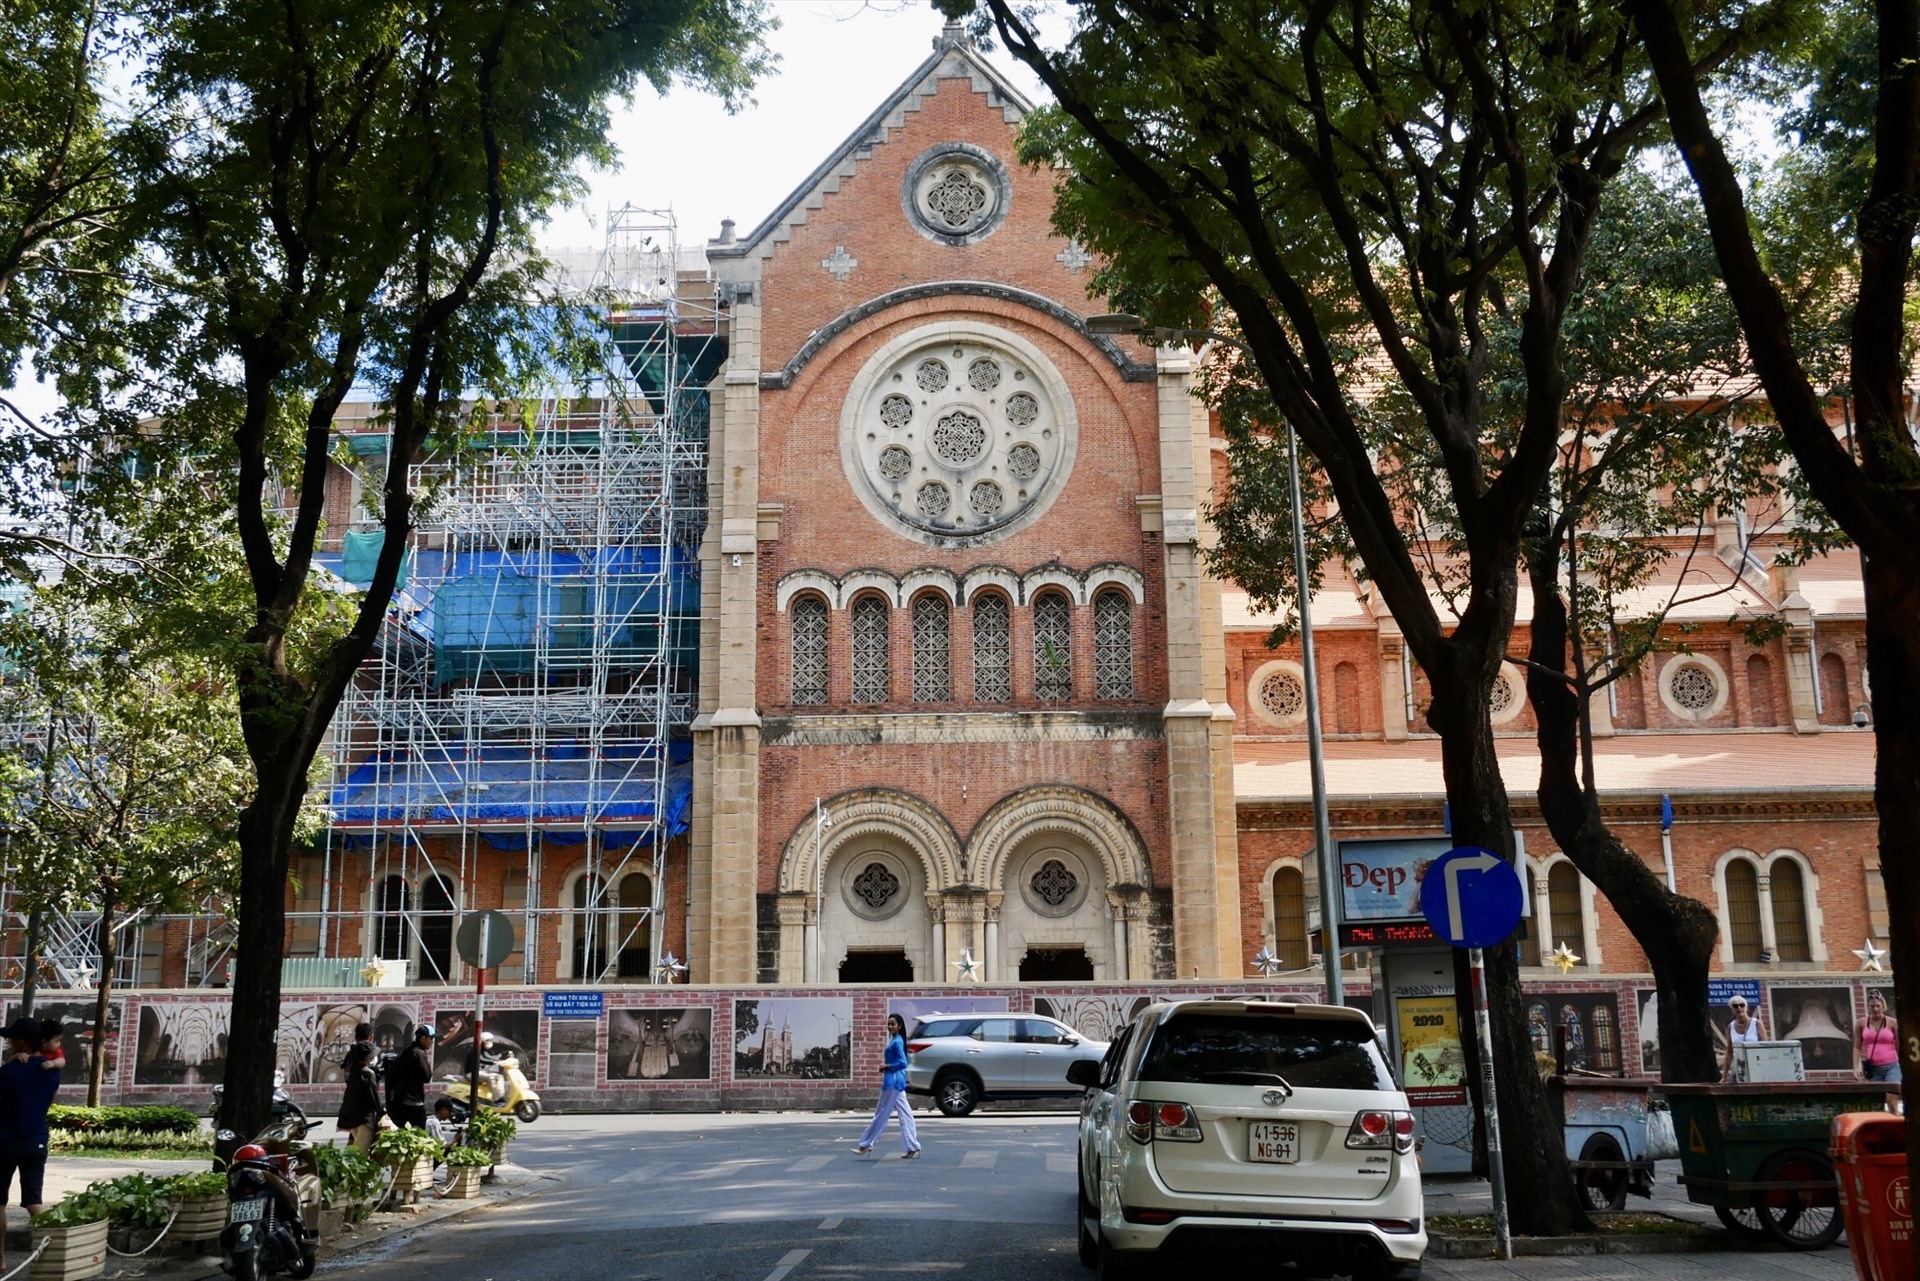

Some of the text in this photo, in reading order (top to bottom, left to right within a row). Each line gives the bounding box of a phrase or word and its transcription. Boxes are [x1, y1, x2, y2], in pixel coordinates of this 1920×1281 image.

[1342, 862, 1406, 895] Đẹp
[1412, 1015, 1444, 1026] 2020
[1483, 1064, 1493, 1081] BNE
[1258, 1142, 1291, 1158] NG-01
